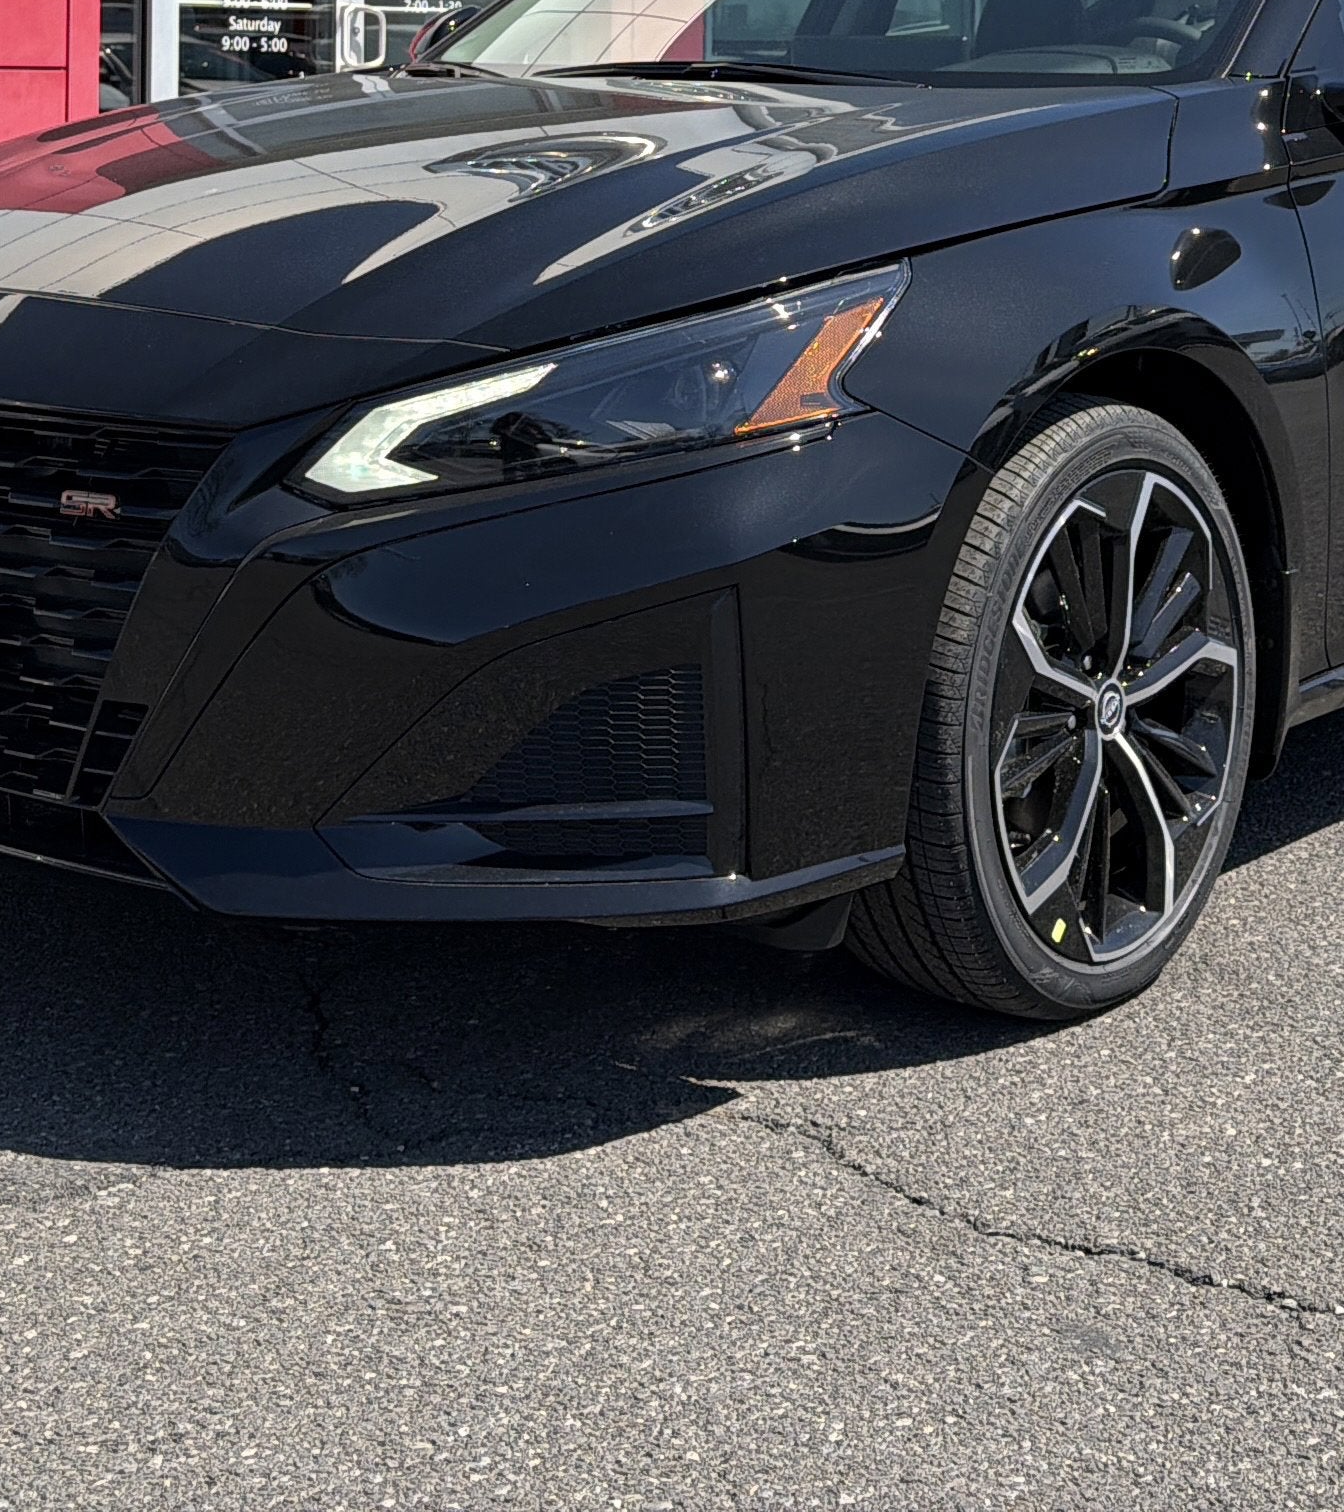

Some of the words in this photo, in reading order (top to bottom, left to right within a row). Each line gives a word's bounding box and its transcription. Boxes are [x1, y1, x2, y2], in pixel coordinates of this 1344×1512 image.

[228, 15, 282, 35] Saturday
[221, 36, 250, 52] 9:00
[260, 37, 288, 53] 5:00
[60, 489, 119, 520] SR
